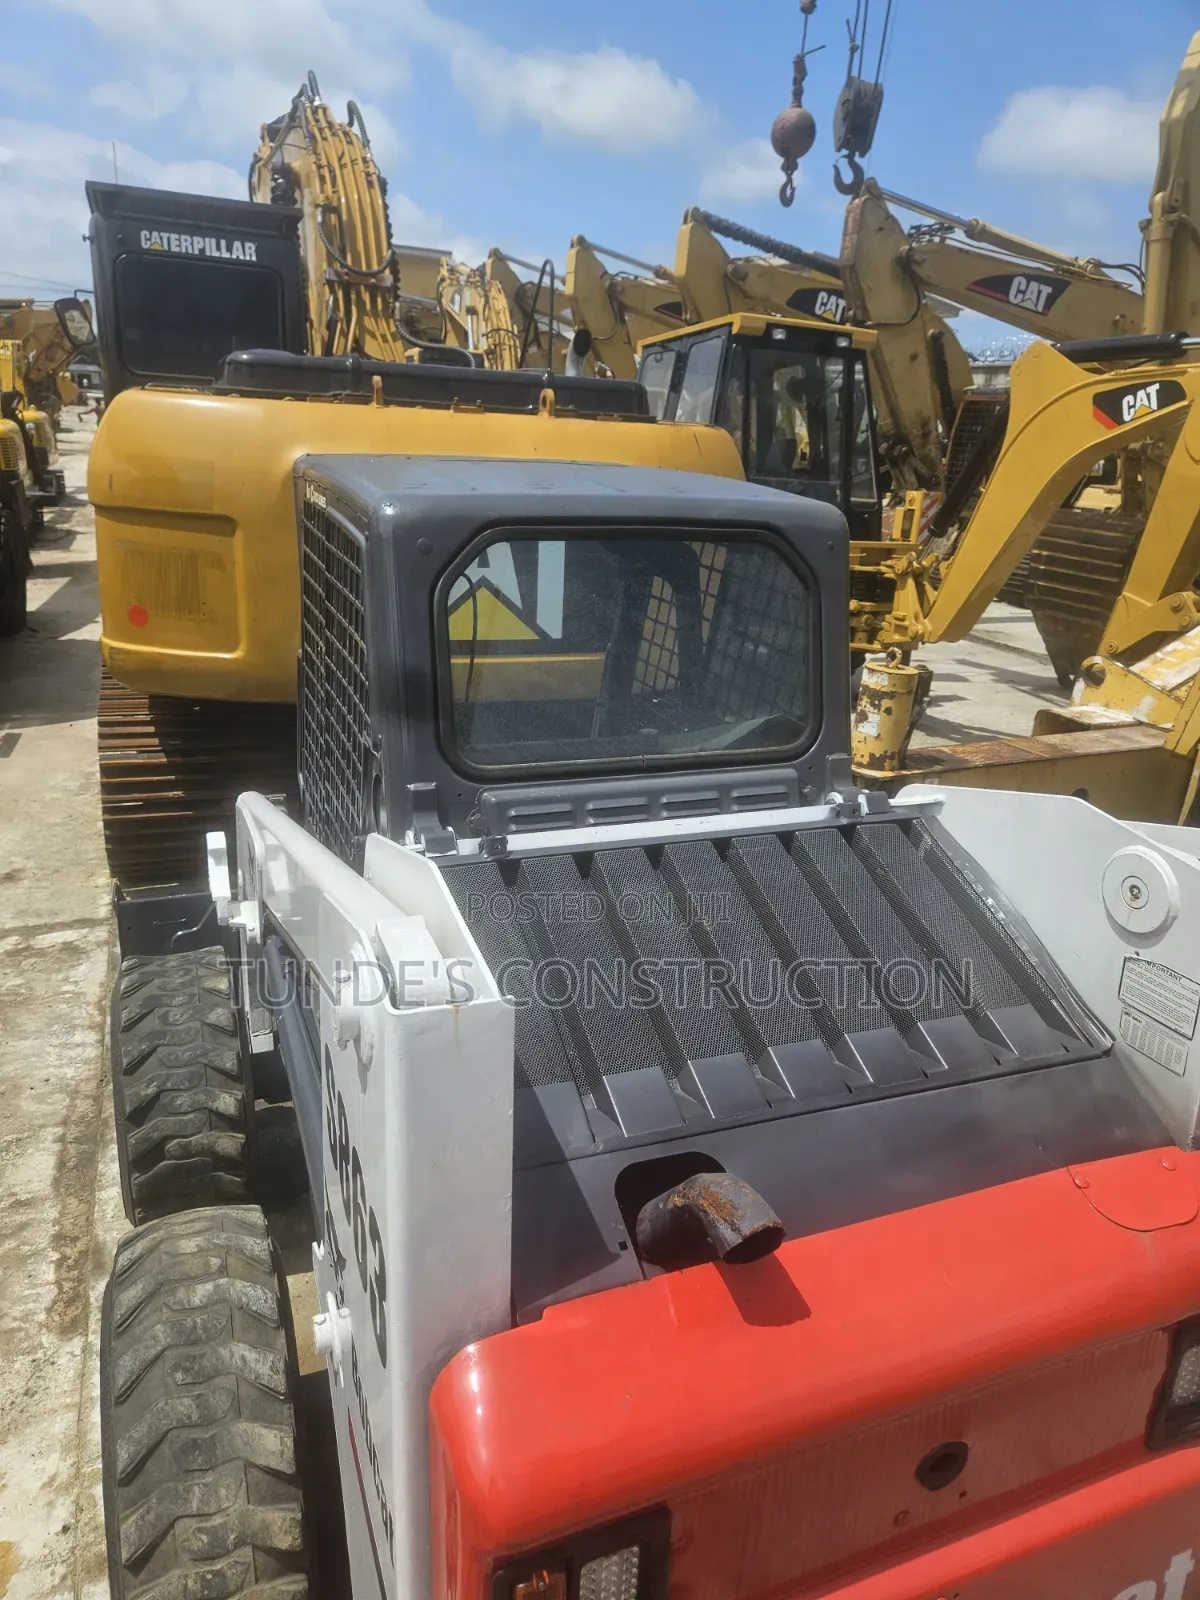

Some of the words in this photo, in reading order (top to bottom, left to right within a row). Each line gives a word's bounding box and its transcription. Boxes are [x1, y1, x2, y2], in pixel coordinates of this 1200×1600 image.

[140, 229, 257, 261] CATERPILLAR
[814, 290, 846, 324] CAT
[1008, 275, 1052, 312] CAT
[1122, 382, 1160, 422] CAT
[1144, 960, 1182, 982] IMPORTANT
